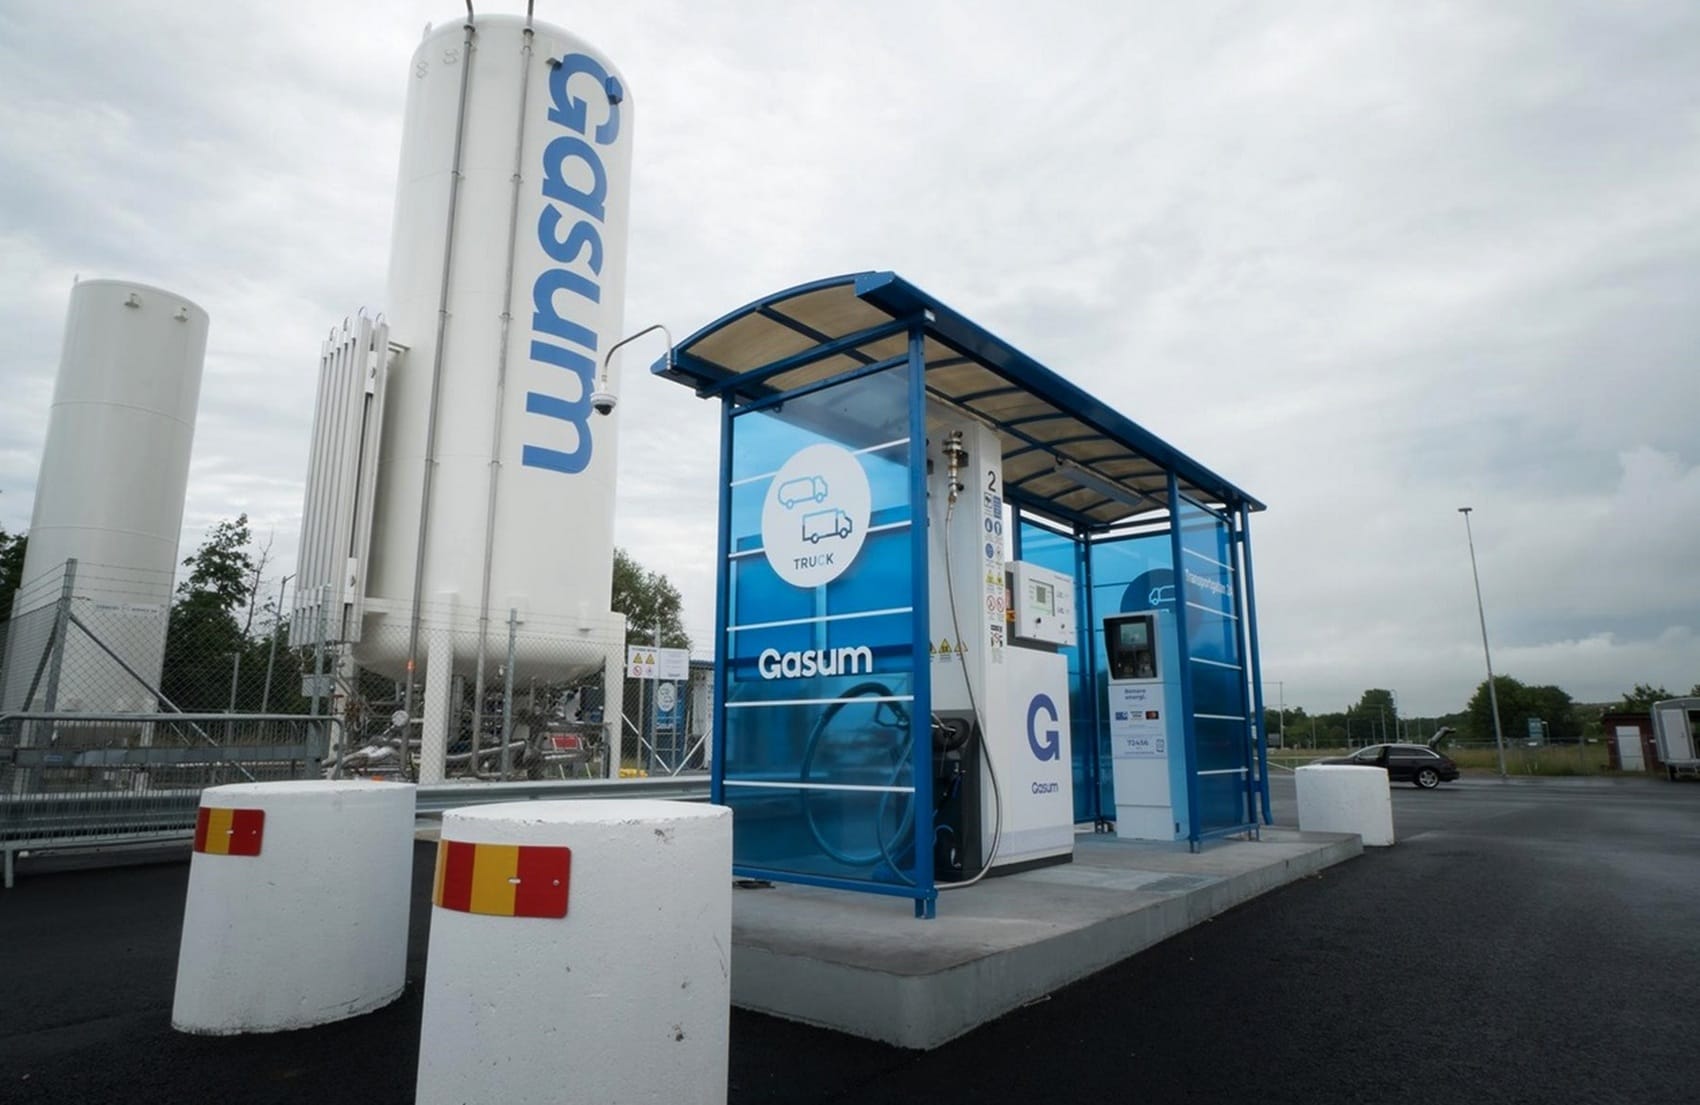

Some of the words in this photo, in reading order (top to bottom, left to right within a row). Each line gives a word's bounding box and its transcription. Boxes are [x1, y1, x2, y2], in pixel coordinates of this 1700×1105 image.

[522, 52, 620, 475] Gasum
[988, 471, 997, 493] 2
[793, 553, 834, 570] TRUCK
[758, 645, 873, 680] Gasum
[1026, 692, 1061, 762] G
[1031, 782, 1060, 795] Gasum
